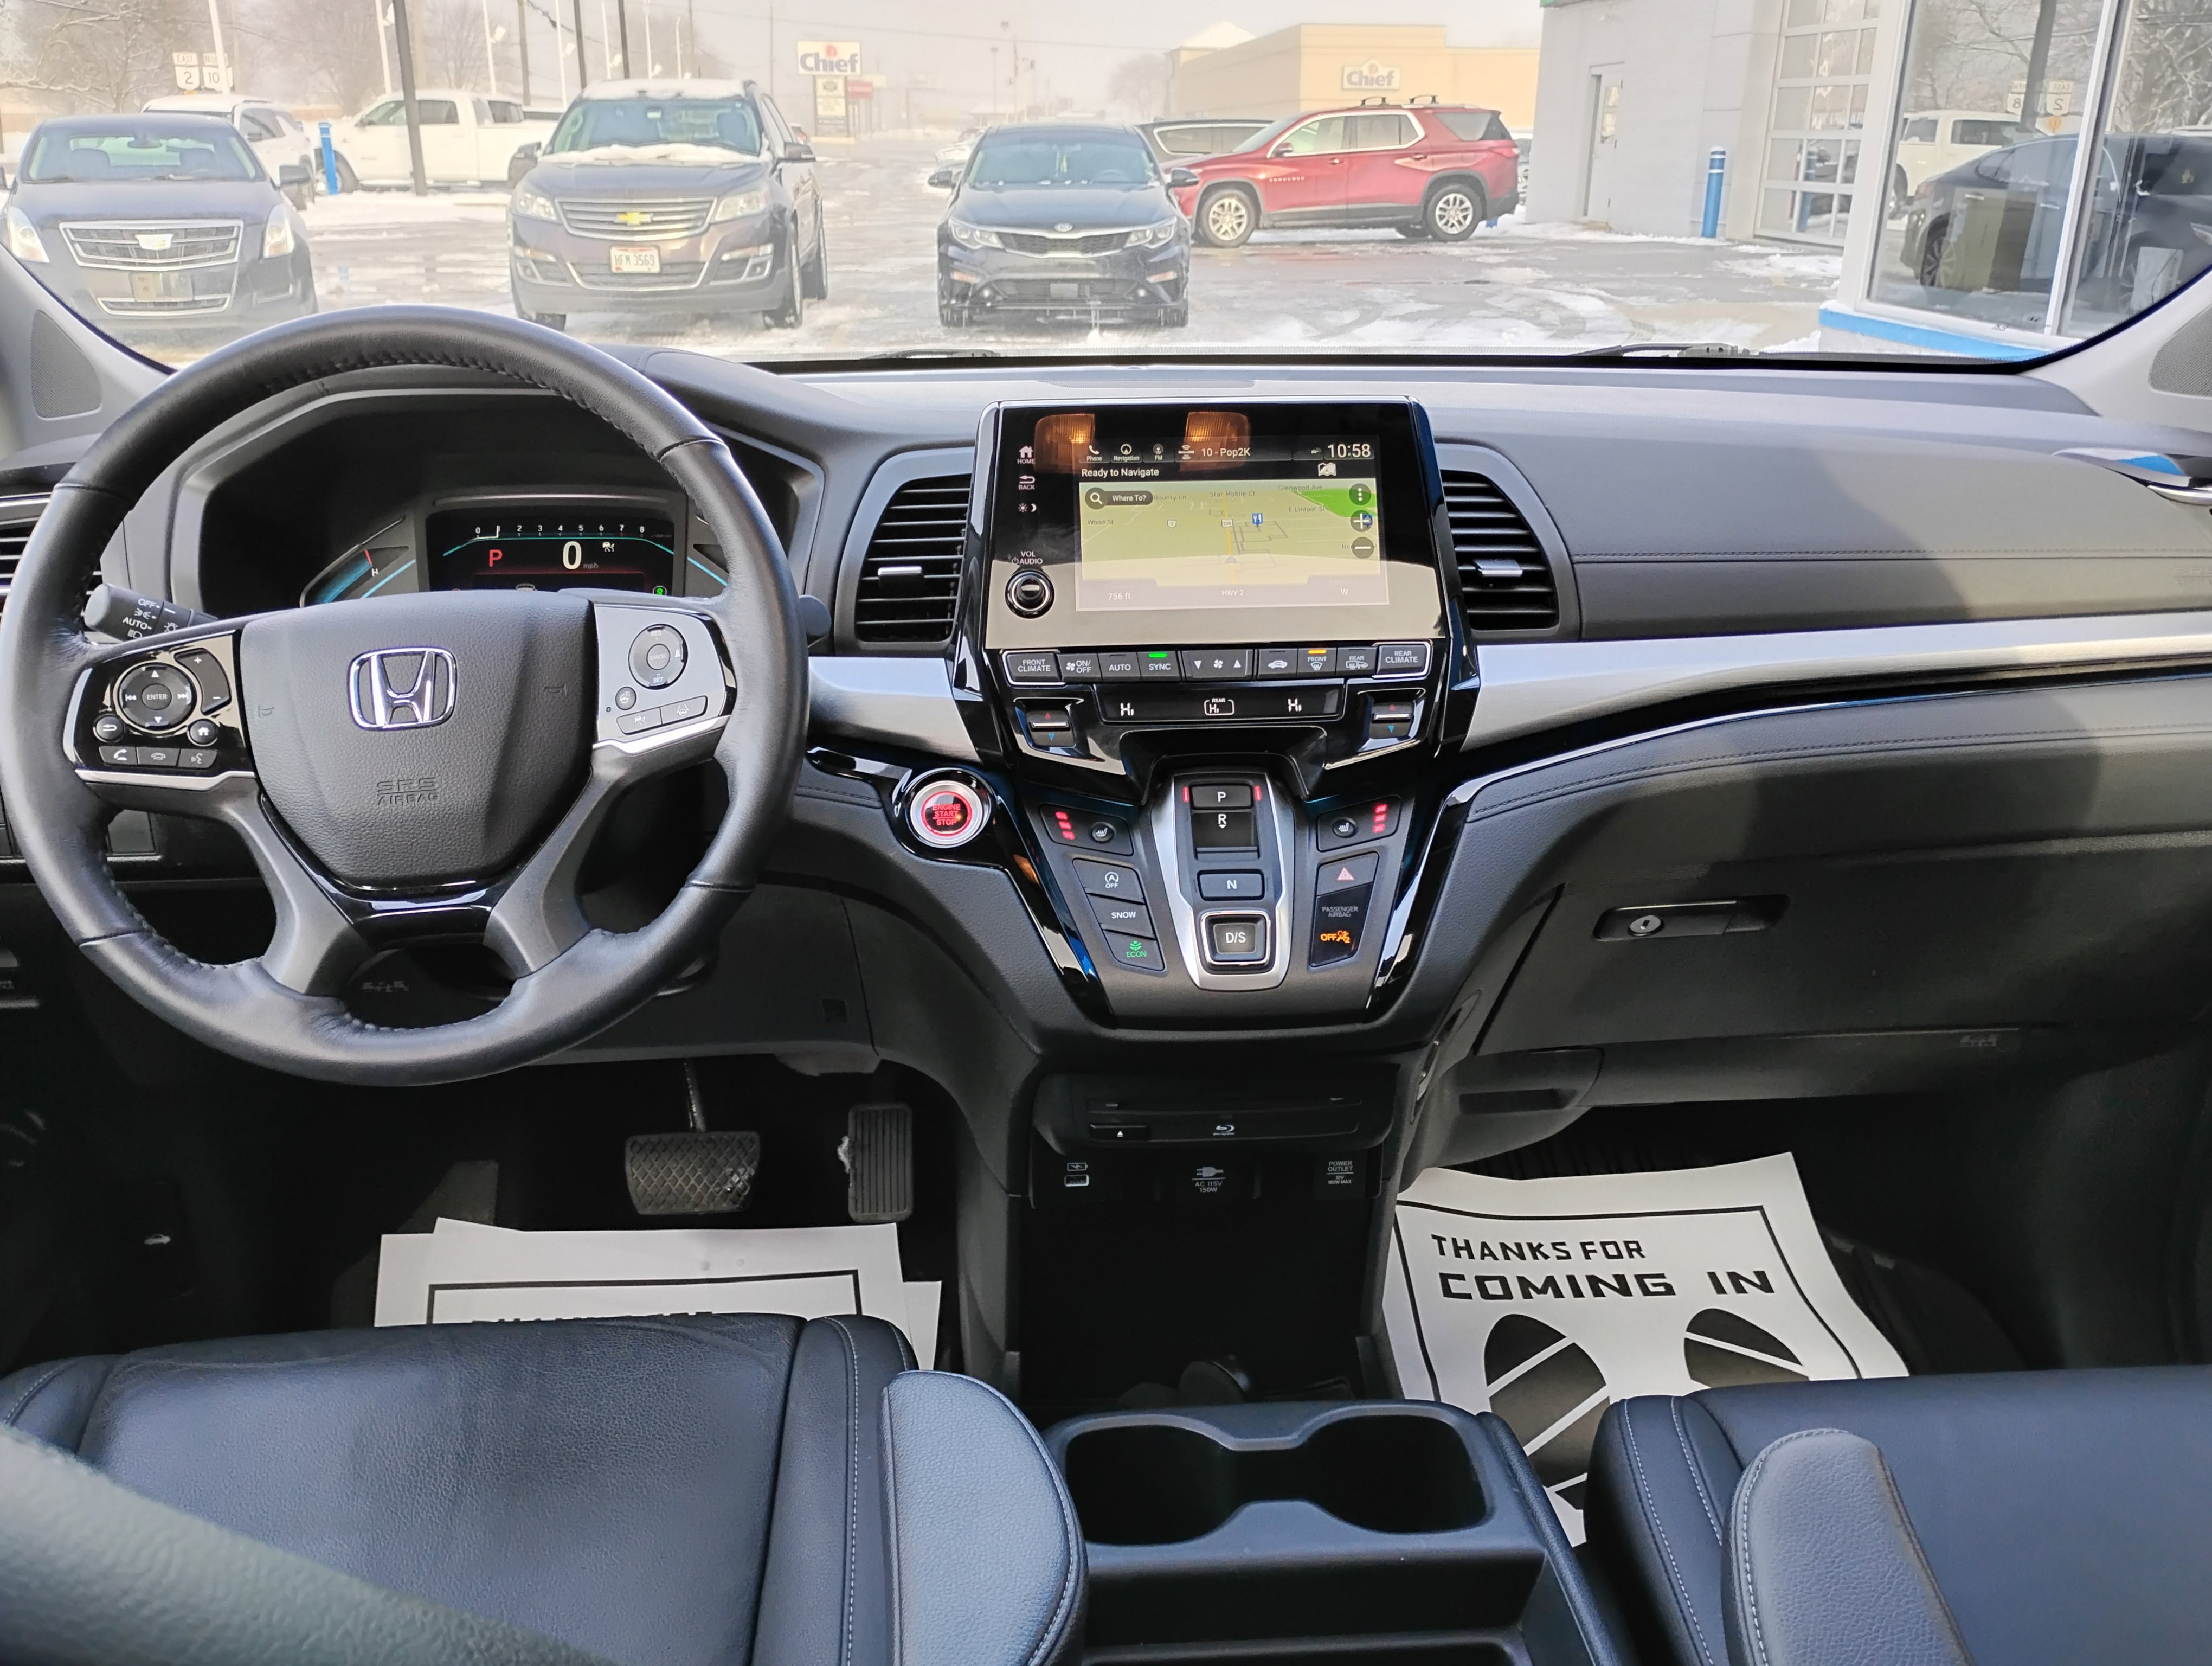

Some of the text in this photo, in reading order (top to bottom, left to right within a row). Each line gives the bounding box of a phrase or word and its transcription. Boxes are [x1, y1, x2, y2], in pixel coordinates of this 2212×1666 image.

[800, 53, 858, 72] Chief
[184, 72, 193, 84] 2
[209, 72, 220, 84] 10
[1346, 70, 1394, 86] Chief
[1201, 448, 1212, 457] 10
[1220, 448, 1251, 458] Pop2K
[1327, 444, 1371, 458] 10:58
[1082, 469, 1108, 478] Ready
[1121, 469, 1160, 478] Navigate
[489, 549, 503, 567] P
[563, 541, 599, 571] 0 mph
[372, 568, 378, 577] H
[138, 598, 156, 608] OFF
[123, 617, 147, 630] AUTO
[377, 777, 435, 792] SRS
[378, 793, 438, 805] AIRBAG
[1217, 792, 1226, 803] P
[1218, 813, 1227, 824] R
[1227, 879, 1237, 890] N
[1225, 932, 1246, 944] D/S
[1320, 933, 1337, 943] OFF
[1431, 1234, 1645, 1261] THANKS FOR
[1439, 1270, 1775, 1300] COMING IN
